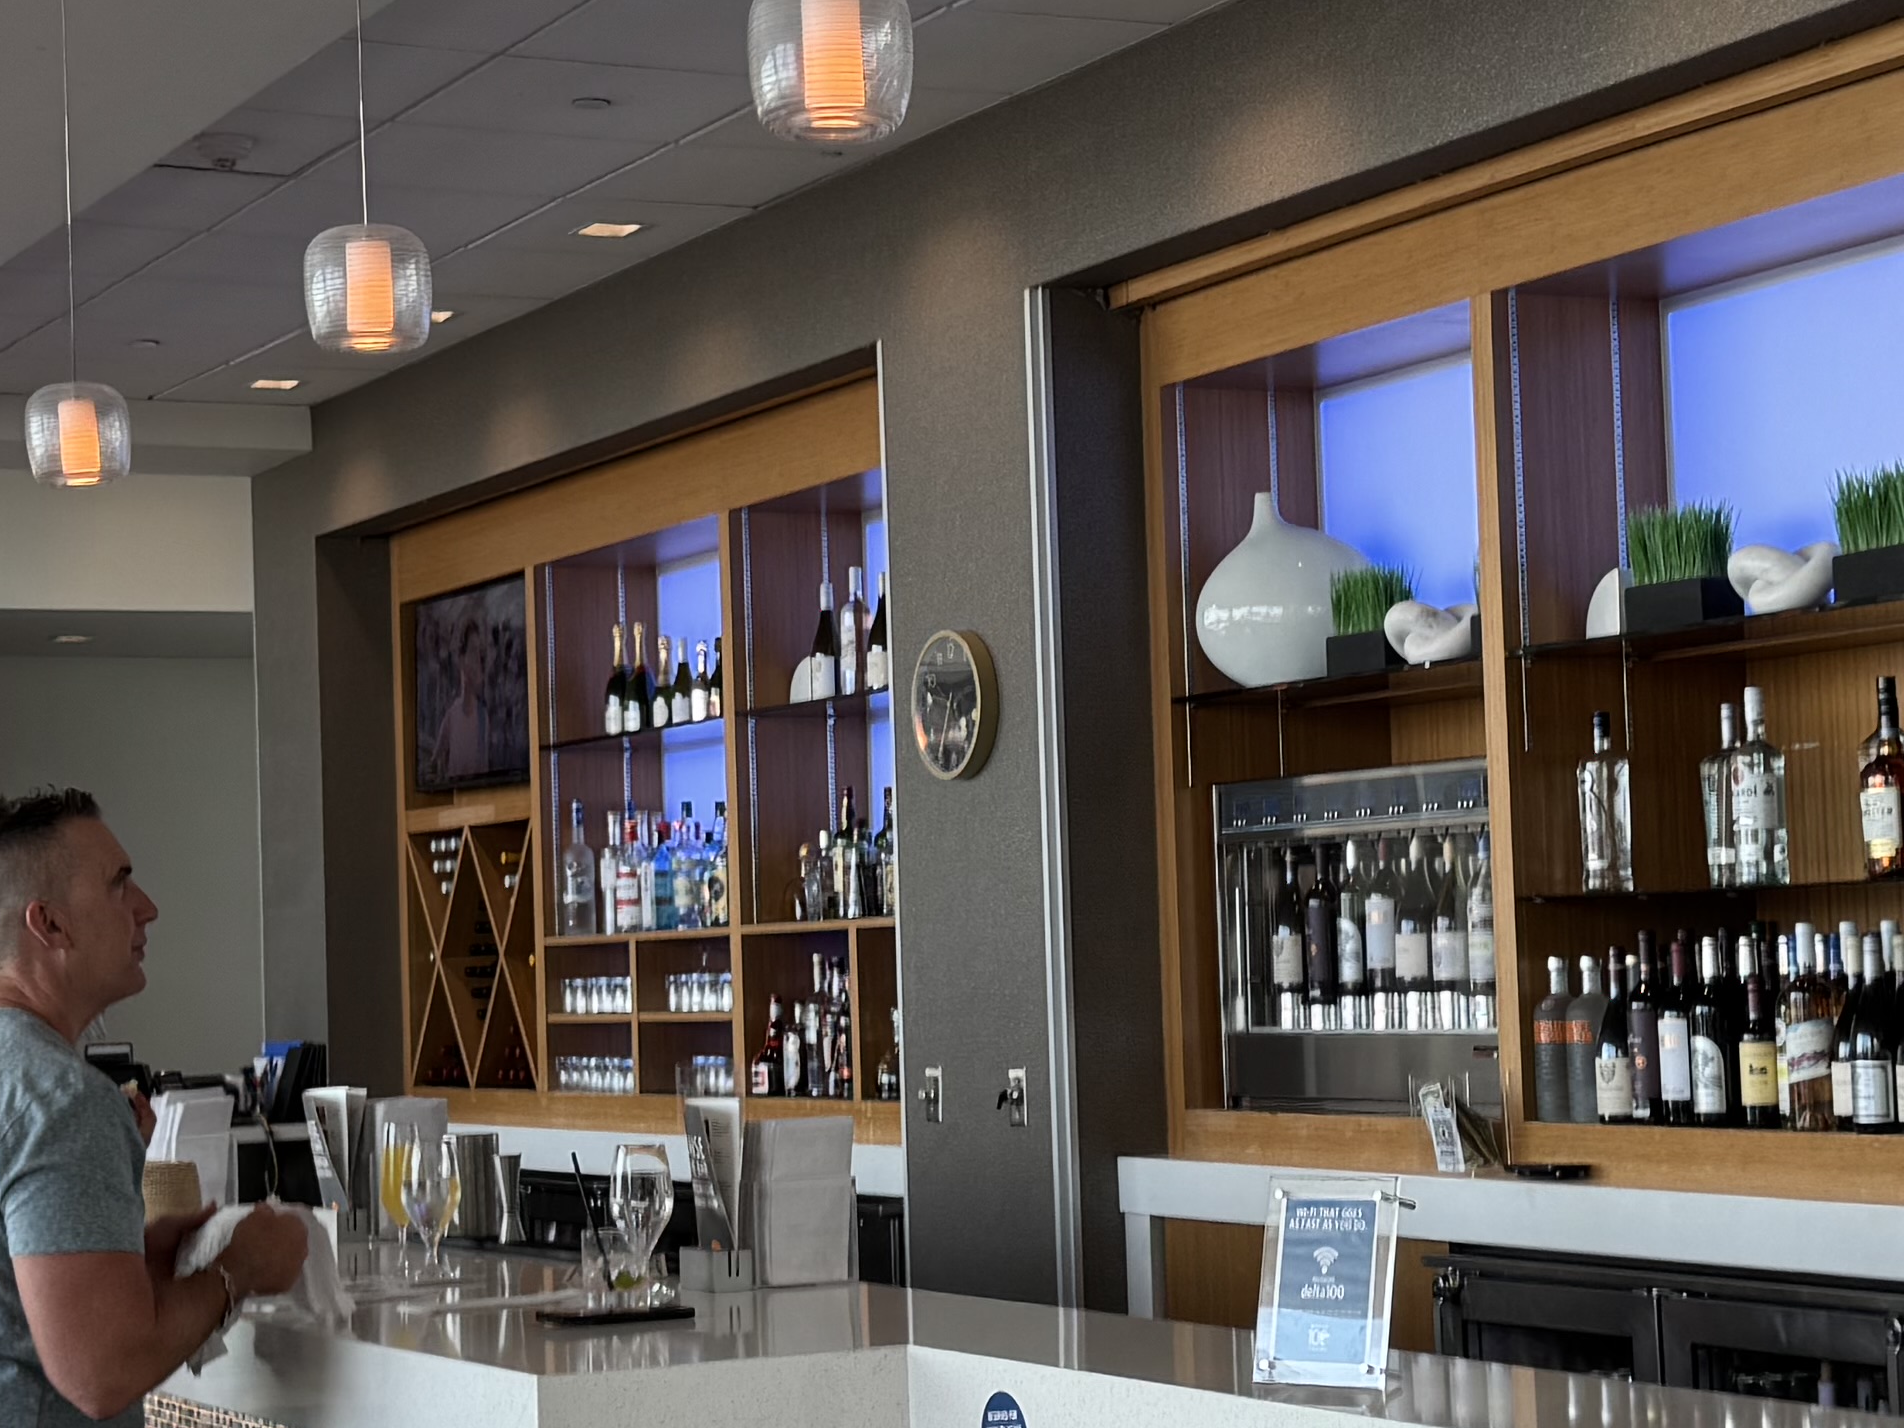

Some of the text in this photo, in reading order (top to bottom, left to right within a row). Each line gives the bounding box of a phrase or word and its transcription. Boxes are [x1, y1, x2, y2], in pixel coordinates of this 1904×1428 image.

[1319, 1206, 1340, 1219] THAT
[1341, 1206, 1363, 1219] GOES
[1289, 1217, 1299, 1230] AS
[1300, 1218, 1320, 1231] FAST
[1322, 1218, 1333, 1231] AS
[1300, 1283, 1345, 1301] delta100
